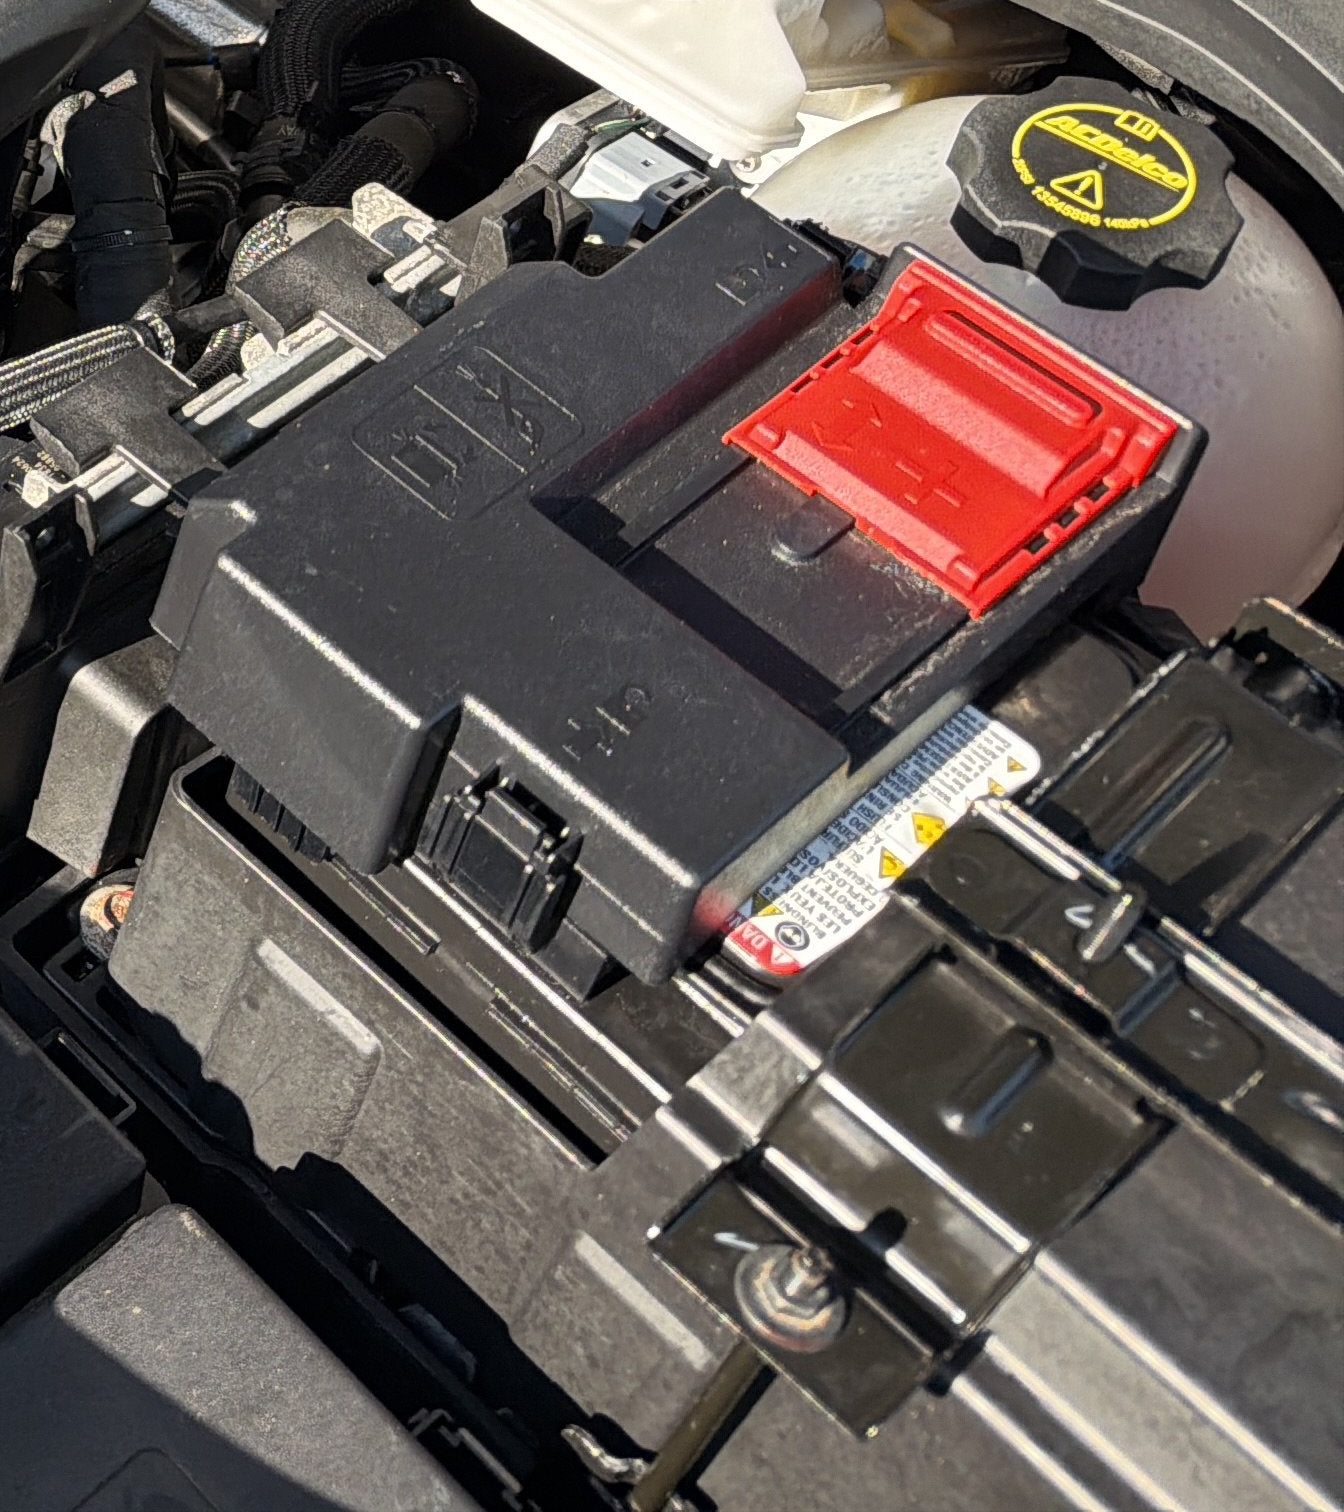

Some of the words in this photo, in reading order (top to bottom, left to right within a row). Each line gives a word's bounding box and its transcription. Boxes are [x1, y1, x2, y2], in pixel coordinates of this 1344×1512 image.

[1042, 116, 1188, 189] ACDelco
[826, 852, 879, 896] CEGUERA
[800, 883, 852, 926] PEUVENT
[816, 911, 841, 934] LES
